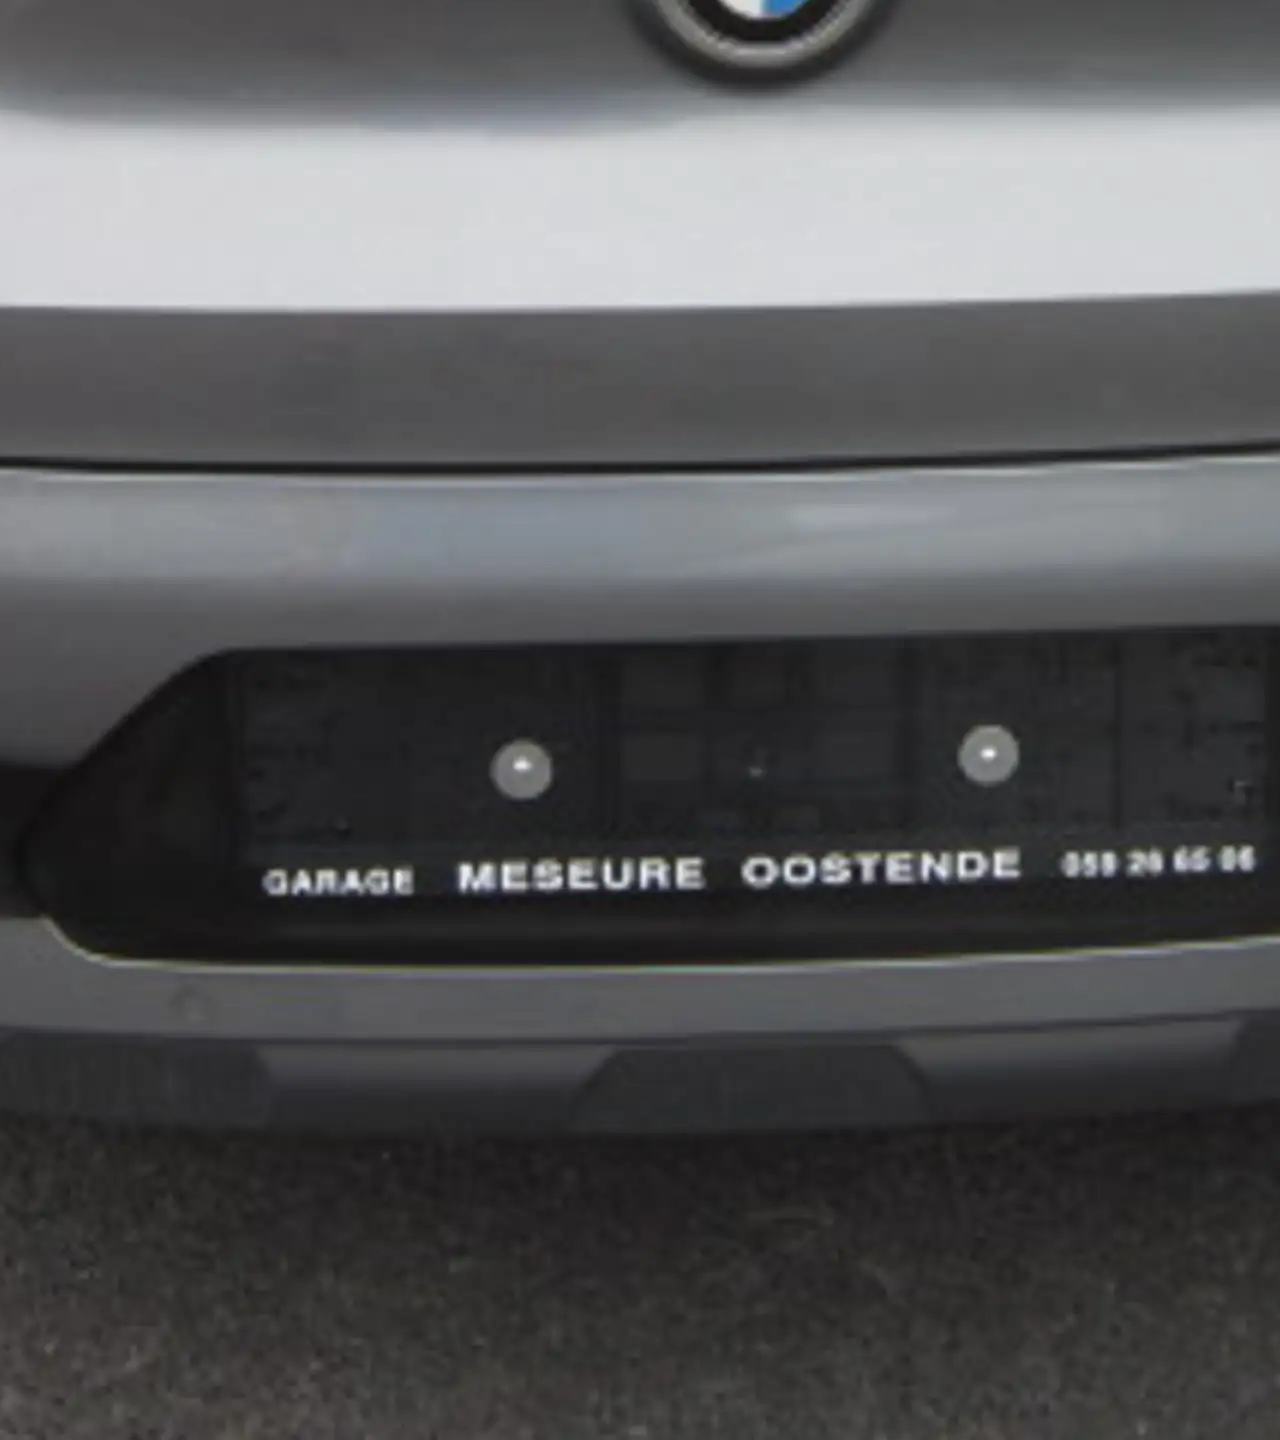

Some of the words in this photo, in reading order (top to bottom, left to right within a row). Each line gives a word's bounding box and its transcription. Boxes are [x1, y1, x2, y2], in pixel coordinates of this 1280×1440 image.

[263, 867, 415, 896] GARAGE
[457, 856, 706, 894] MESEURE
[740, 848, 1022, 888] OOSTENDE
